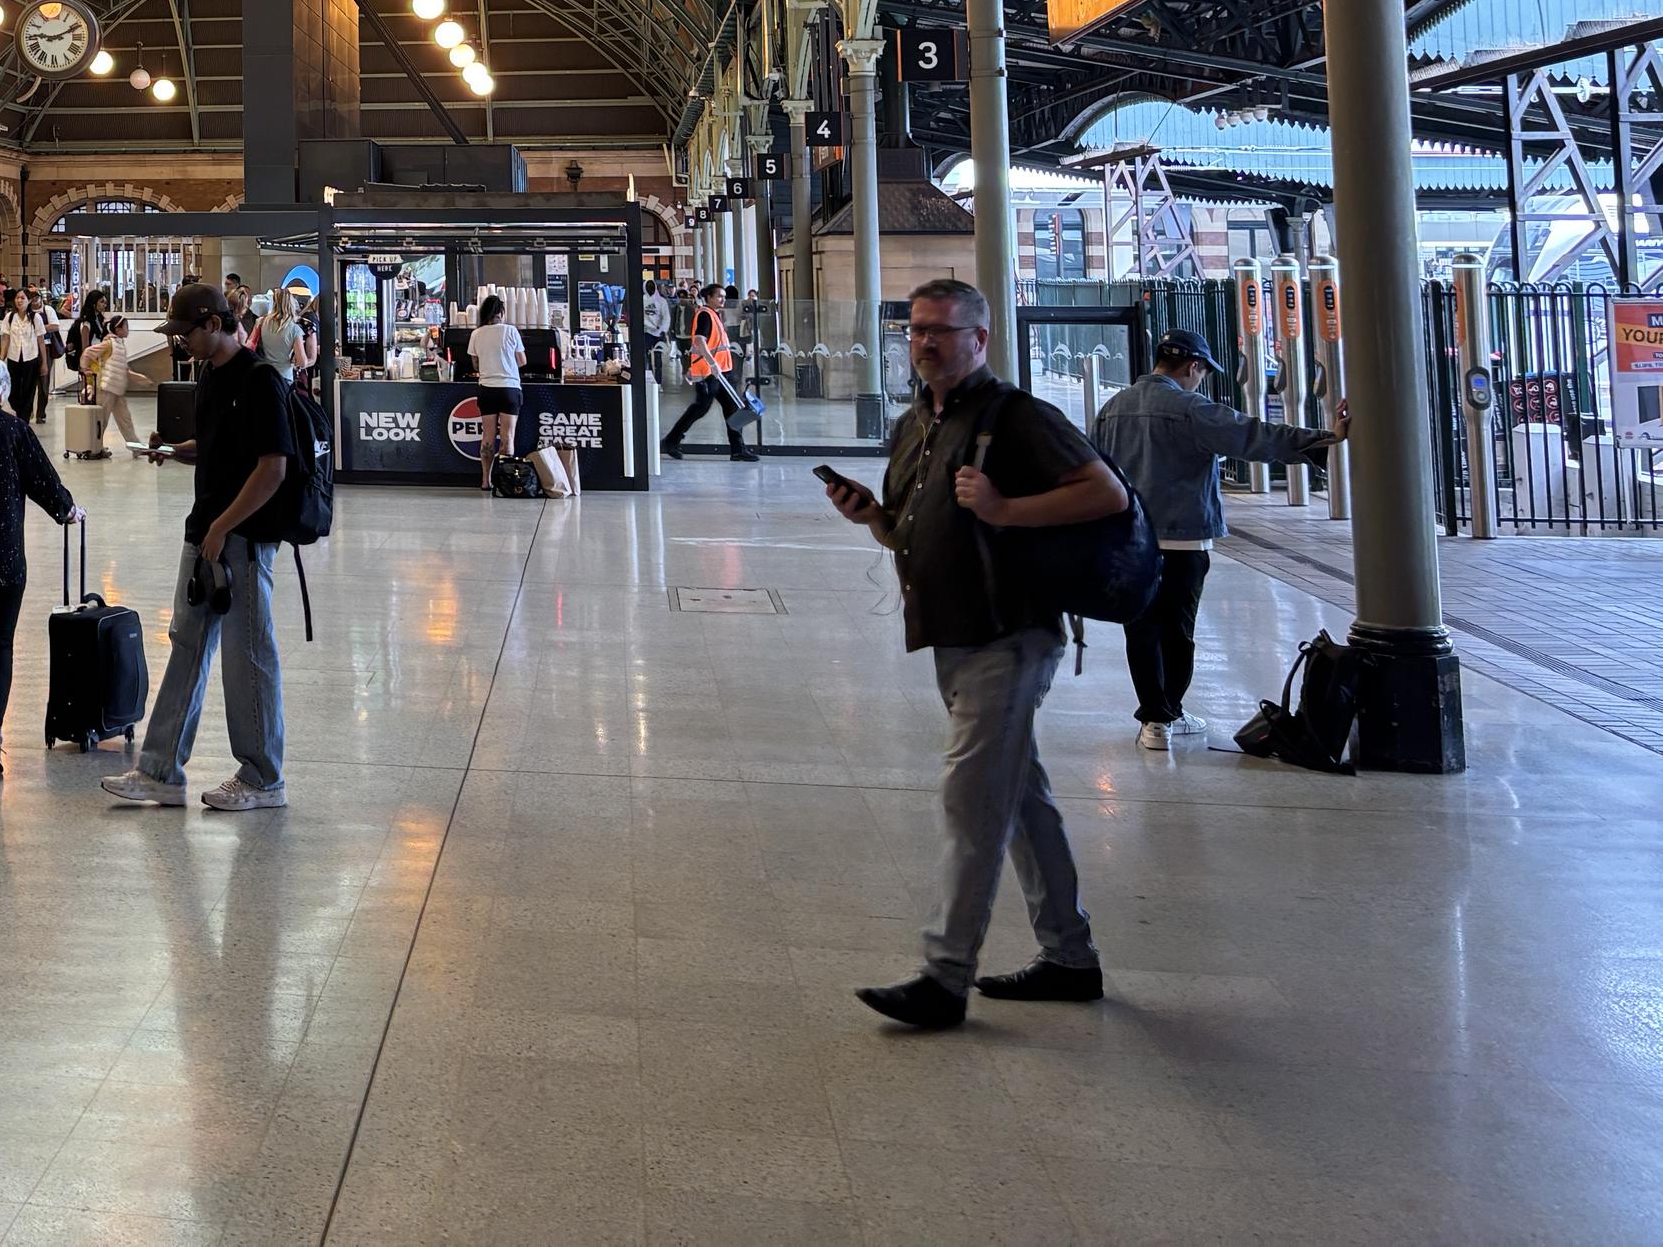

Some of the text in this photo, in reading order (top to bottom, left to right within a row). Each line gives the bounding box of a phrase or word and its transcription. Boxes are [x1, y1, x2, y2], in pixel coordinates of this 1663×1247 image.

[918, 41, 938, 69] 3
[816, 119, 831, 139] 4
[765, 159, 776, 174] 5
[733, 182, 743, 194] 6
[714, 199, 722, 209] 7
[699, 210, 707, 219] 8
[688, 218, 695, 227] 9
[377, 264, 393, 272] HERE
[359, 412, 421, 428] NEW
[538, 412, 602, 426] SAME
[359, 427, 421, 442] LOOK
[538, 425, 602, 437] GREAT
